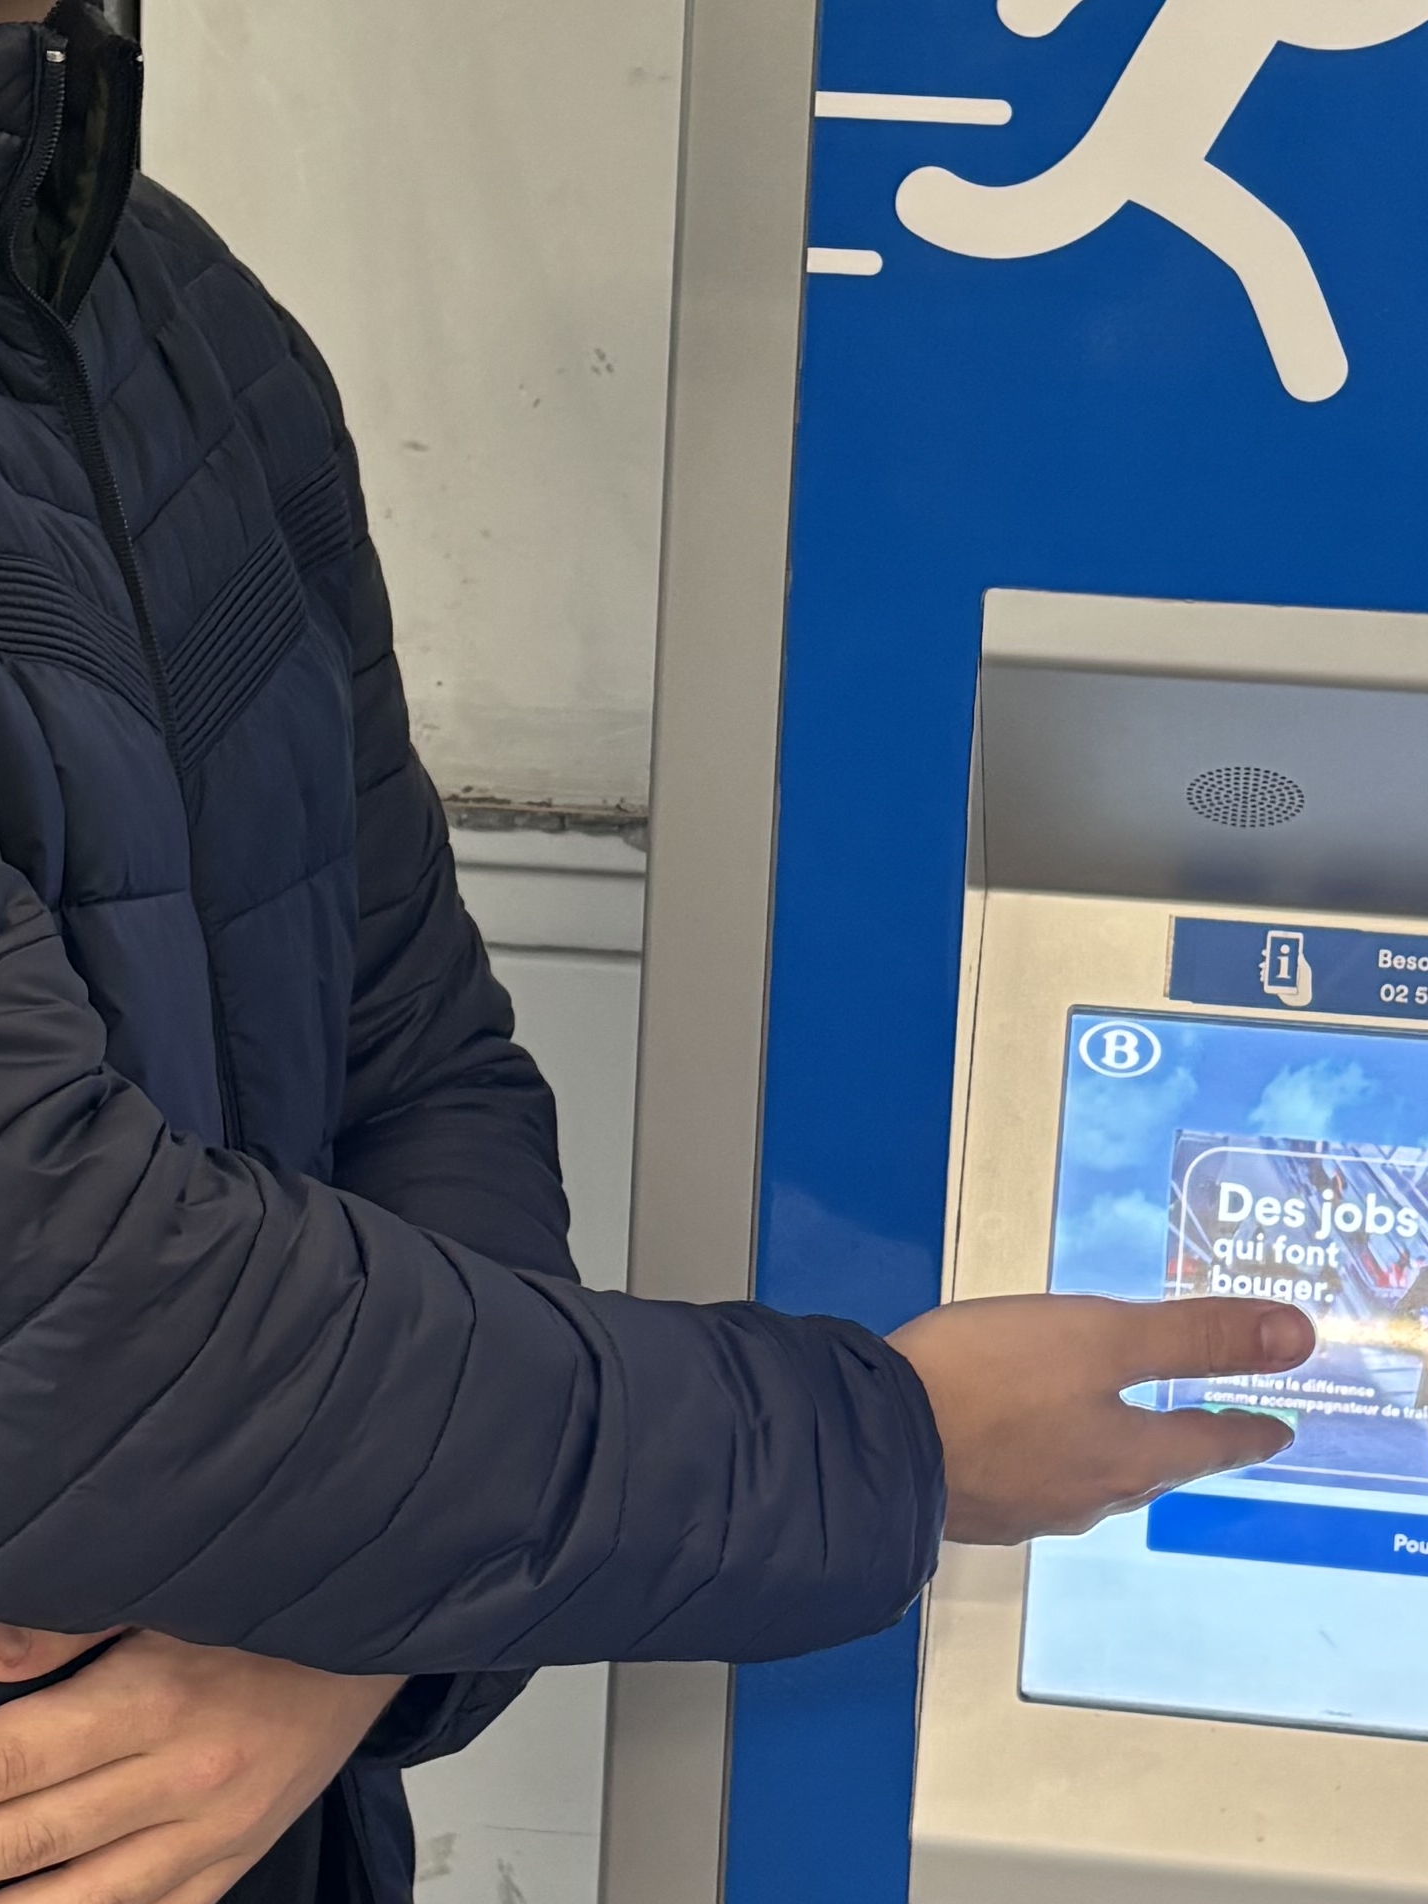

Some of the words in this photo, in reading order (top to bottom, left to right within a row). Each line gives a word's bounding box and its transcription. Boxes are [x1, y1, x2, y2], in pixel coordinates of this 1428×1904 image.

[1380, 983, 1409, 1003] 02
[1218, 1182, 1306, 1228] Des
[1315, 1188, 1420, 1240] jobs
[1213, 1233, 1264, 1264] qui
[1273, 1234, 1339, 1268] font
